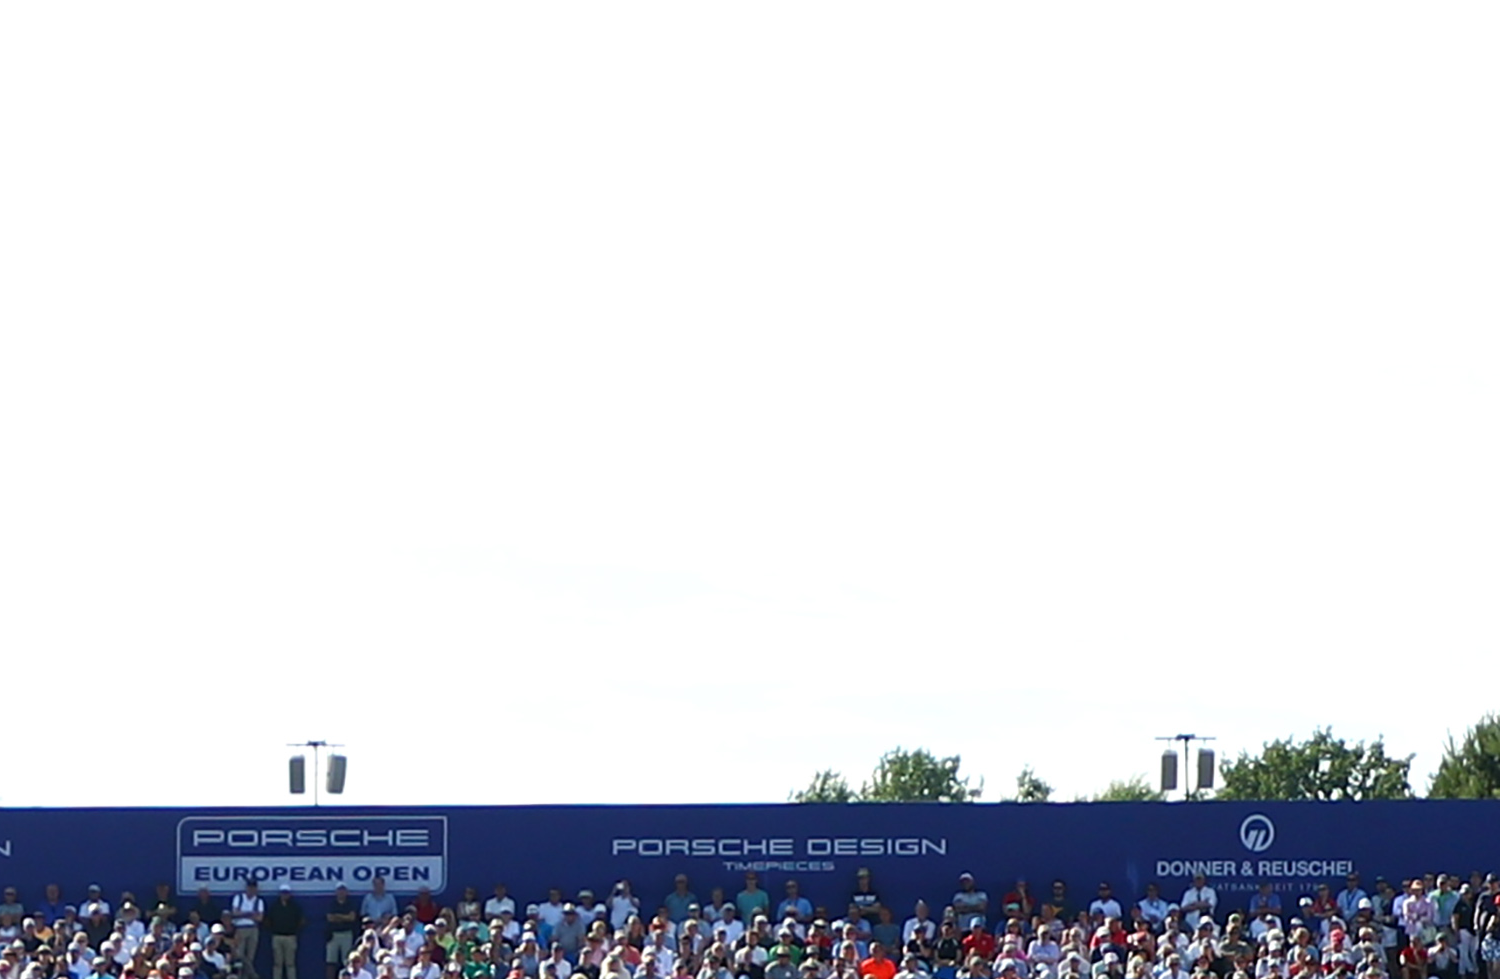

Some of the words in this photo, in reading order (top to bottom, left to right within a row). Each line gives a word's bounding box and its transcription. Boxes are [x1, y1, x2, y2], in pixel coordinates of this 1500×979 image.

[193, 829, 430, 847] PORSCHE
[612, 839, 794, 856] PORSCHE
[807, 838, 946, 856] DESIGN
[194, 865, 344, 882] EUROPEAN
[353, 865, 430, 882] OPEN
[723, 861, 835, 871] TIMEPIECES
[1156, 860, 1236, 877] DONNER
[1240, 860, 1254, 876] &
